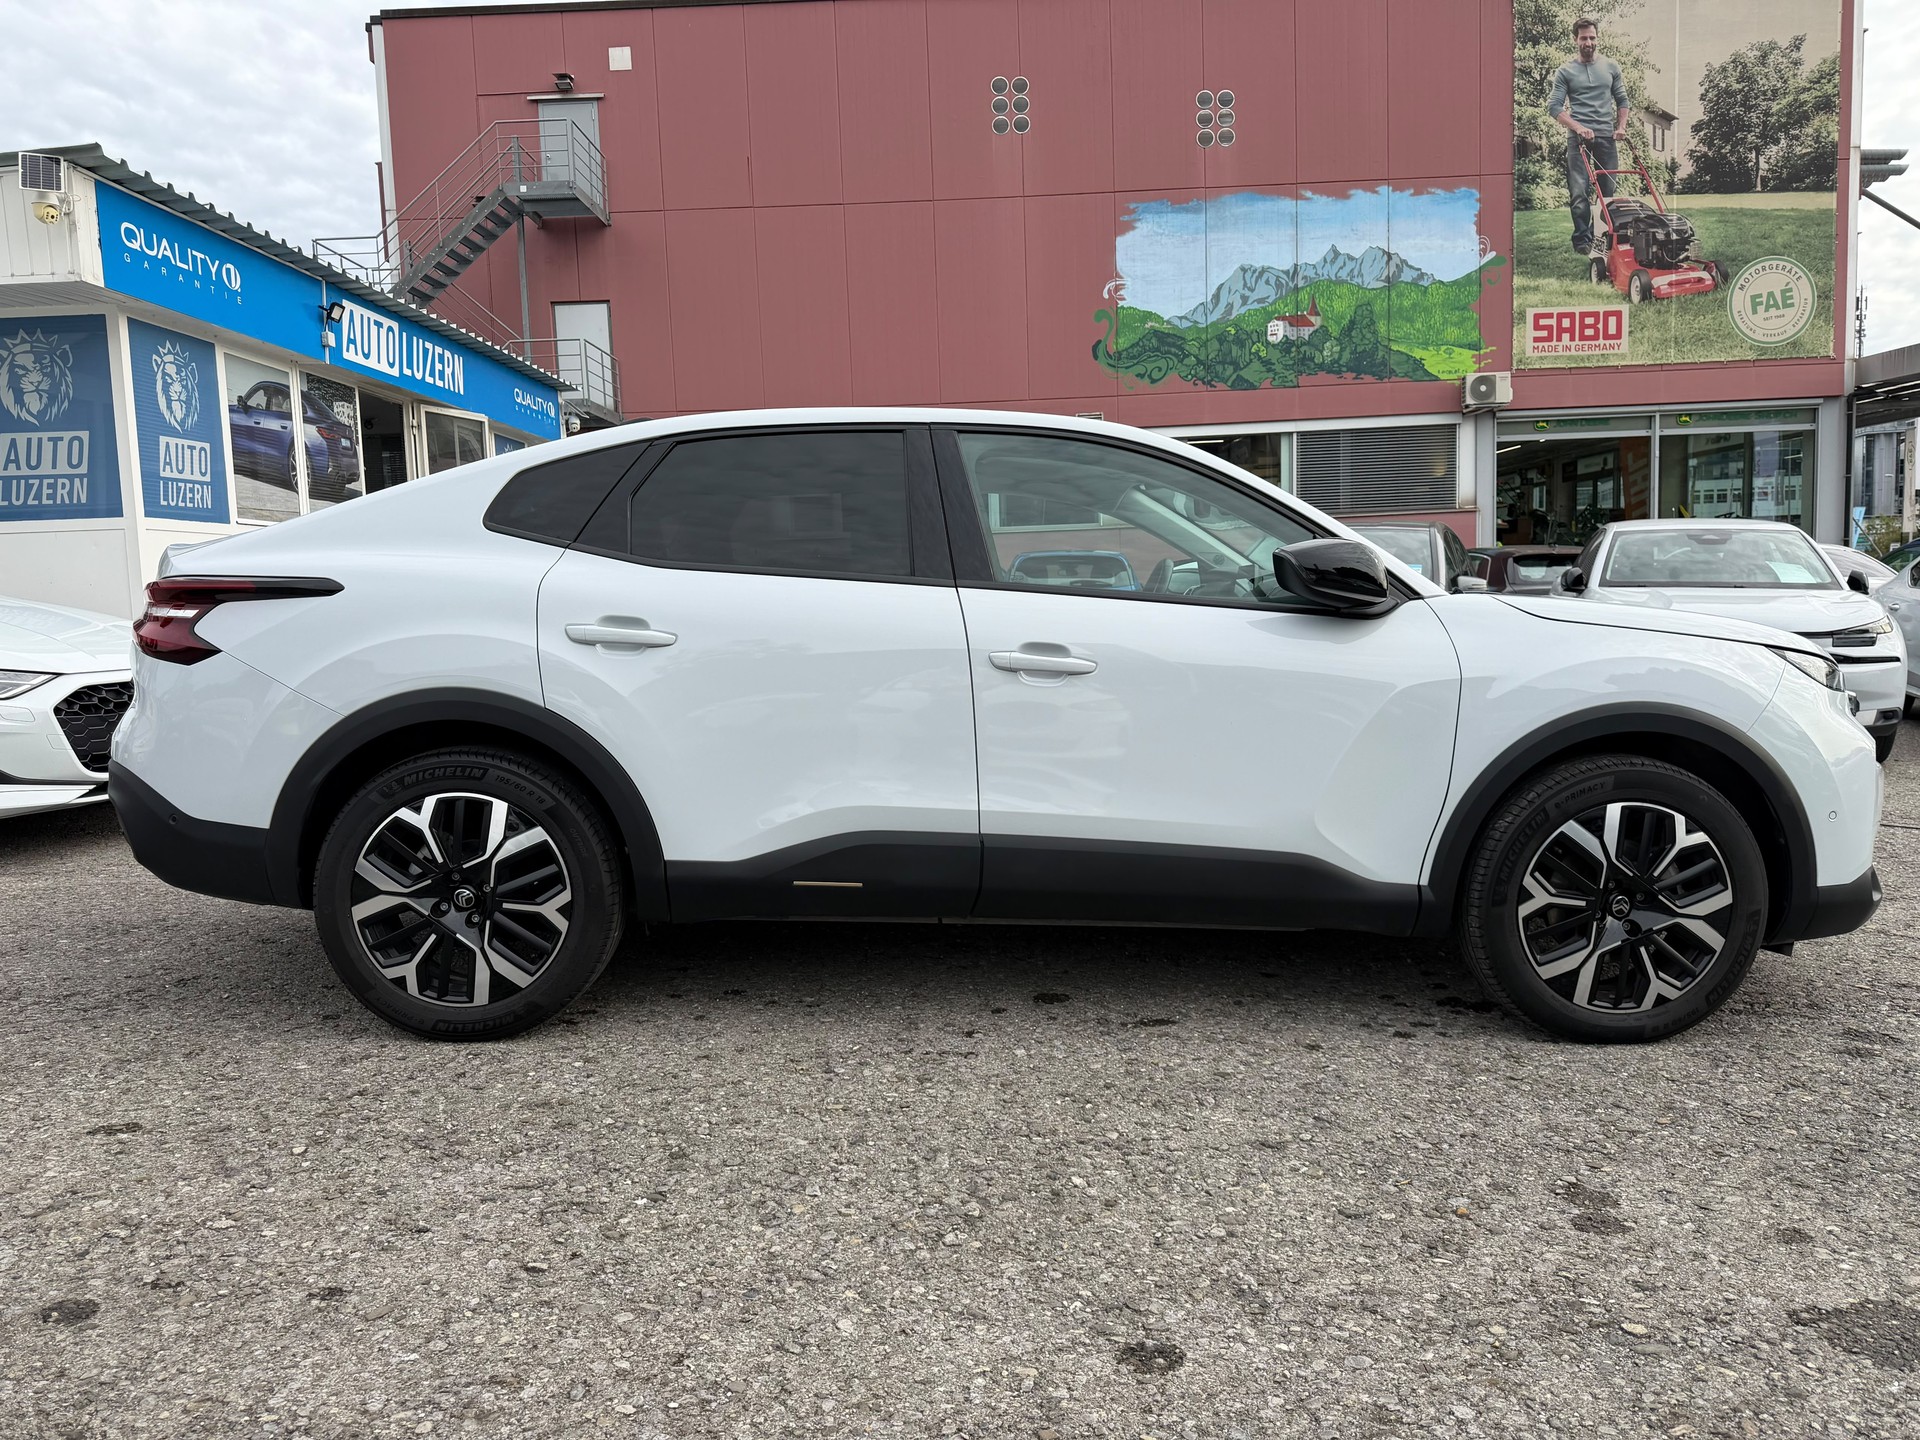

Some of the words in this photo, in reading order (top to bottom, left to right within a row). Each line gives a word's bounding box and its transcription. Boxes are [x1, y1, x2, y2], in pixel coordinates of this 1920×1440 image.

[120, 222, 219, 281] QUALITY
[124, 253, 242, 304] GARANTIE
[1738, 264, 1803, 291] MOTORGERÄTE
[1533, 310, 1623, 343] SABO
[1737, 310, 1756, 334] BERATUNG
[1792, 298, 1808, 328] REPARATUR
[346, 309, 396, 369] AUTO
[402, 332, 464, 395] LUZERN
[1533, 345, 1559, 353] MADE
[1562, 344, 1572, 353] IN
[1574, 343, 1622, 352] GERMANY
[514, 388, 547, 414] QUALITY
[3, 435, 84, 471] AUTO
[162, 441, 208, 477] AUTO
[160, 480, 211, 509] LUZERN
[404, 768, 485, 786] MICHELIN
[495, 775, 527, 791] 195/60
[527, 790, 535, 798] R
[437, 1010, 515, 1028] MICHELIN
